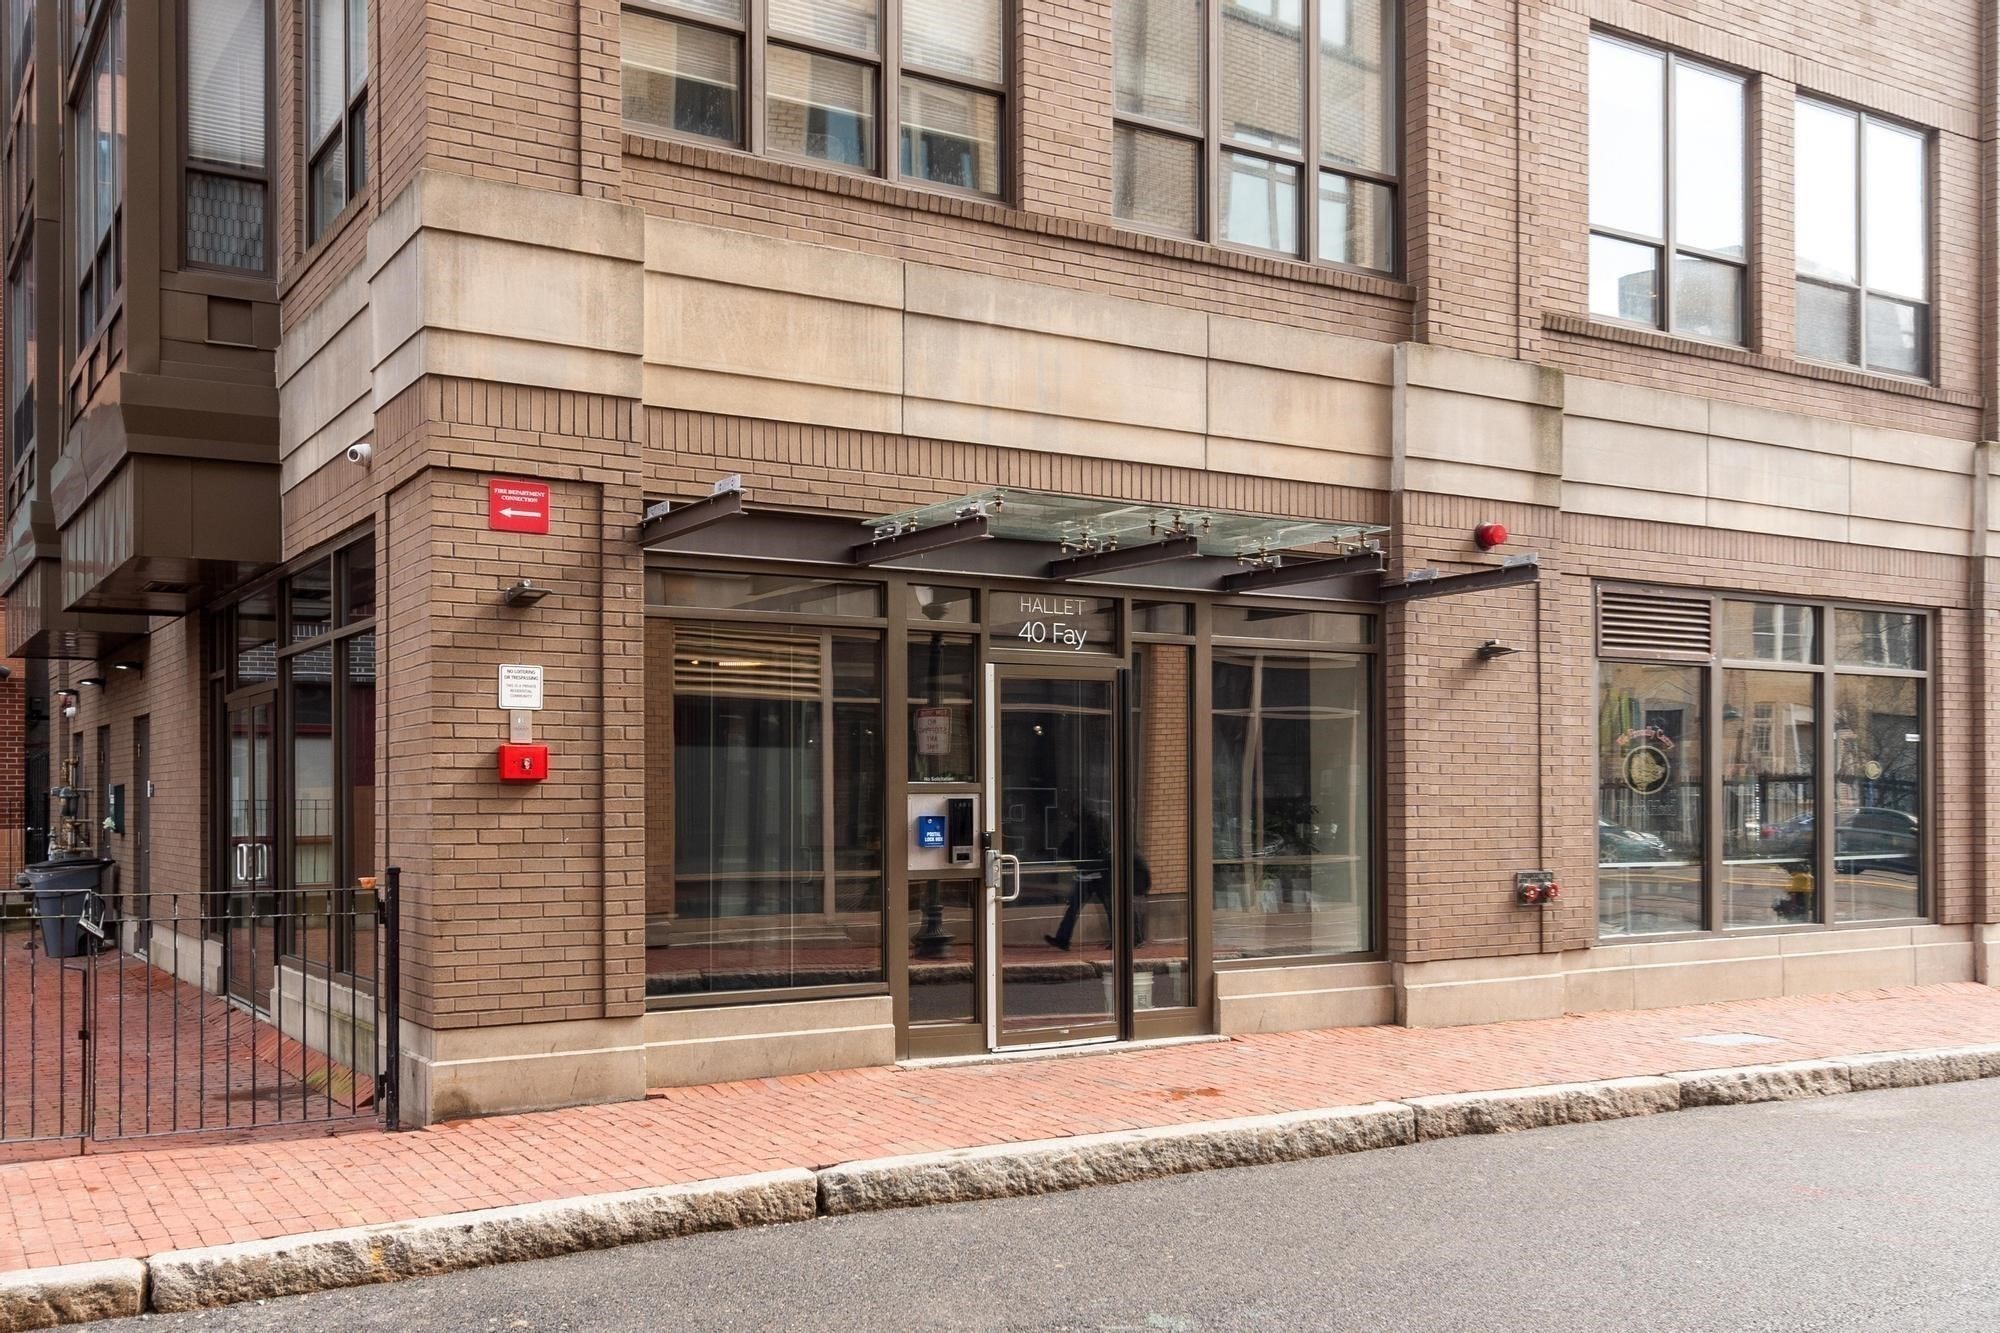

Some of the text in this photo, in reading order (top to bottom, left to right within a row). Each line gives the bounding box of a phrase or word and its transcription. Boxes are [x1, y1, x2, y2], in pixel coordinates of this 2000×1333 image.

[1020, 596, 1086, 616] HALLET
[1018, 621, 1087, 651] 40 Fay
